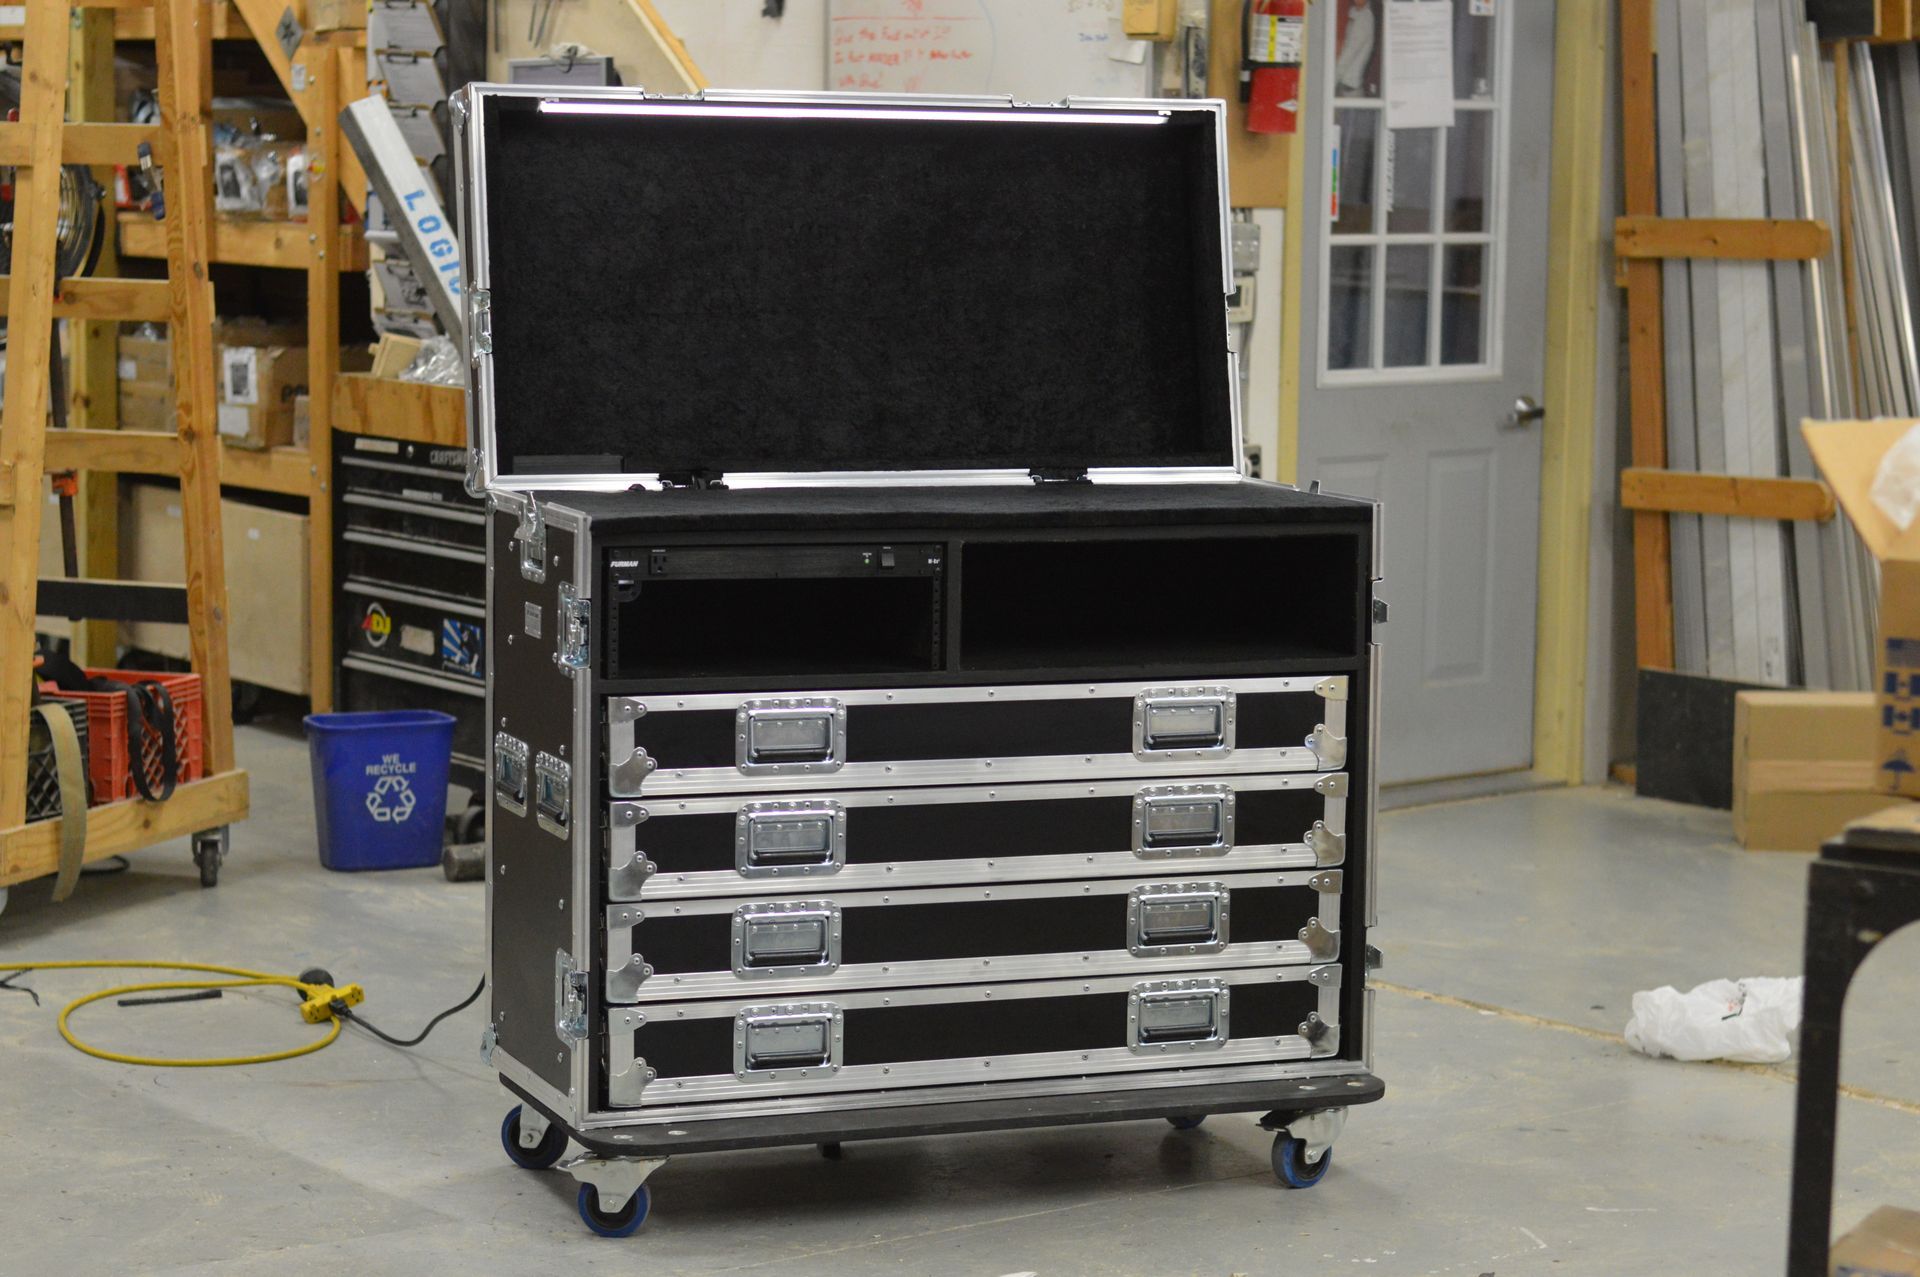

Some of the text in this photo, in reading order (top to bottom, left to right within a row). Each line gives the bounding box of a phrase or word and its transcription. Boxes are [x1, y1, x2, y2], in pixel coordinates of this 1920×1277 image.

[610, 560, 639, 568] FURMAN
[382, 753, 400, 764] WE
[366, 761, 417, 776] RECYCLE
